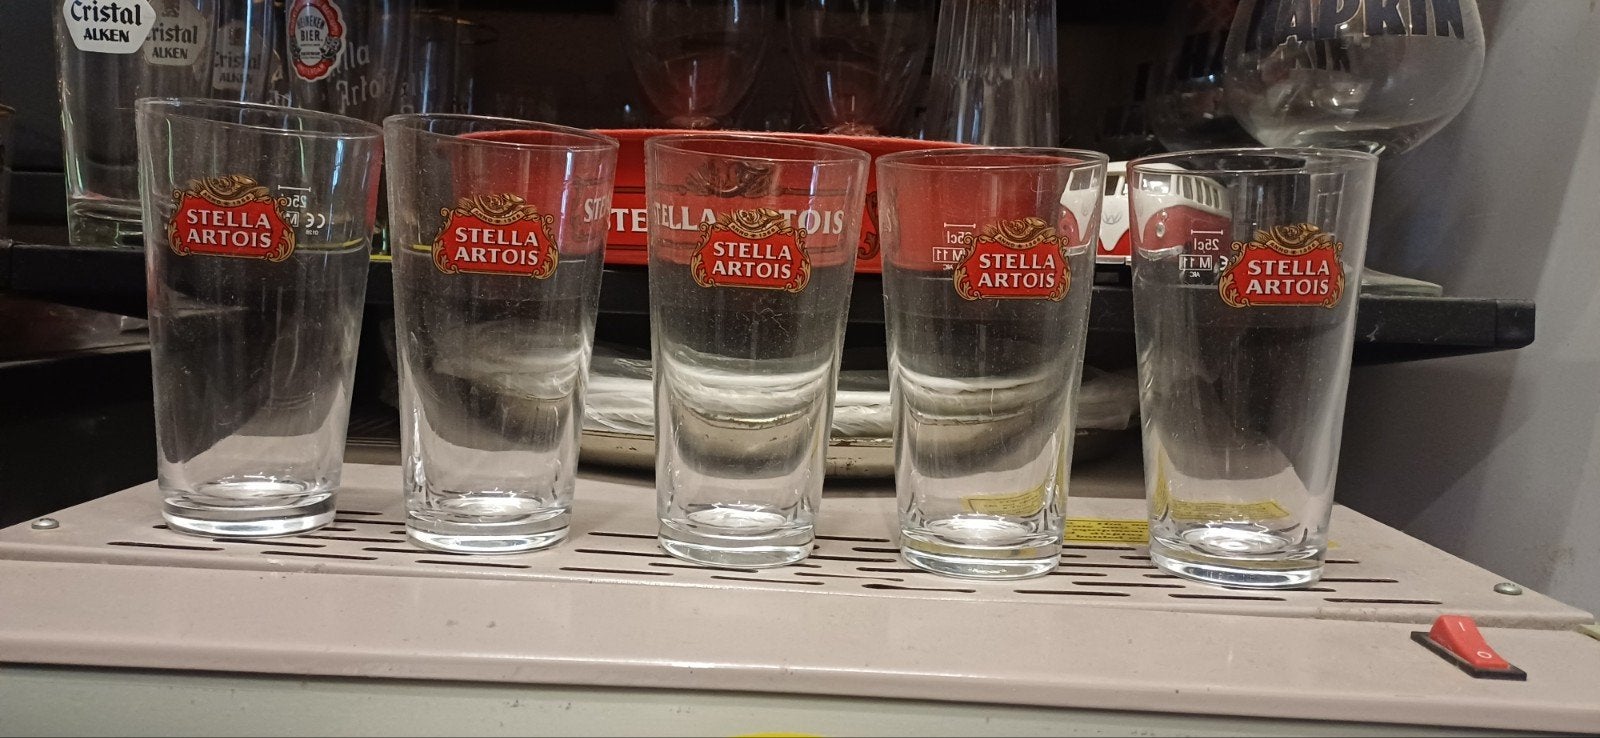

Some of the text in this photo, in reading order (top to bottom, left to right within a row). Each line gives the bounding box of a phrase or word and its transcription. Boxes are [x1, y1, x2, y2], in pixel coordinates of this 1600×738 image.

[70, 0, 142, 26] Cristal
[84, 28, 130, 42] ALKEN
[147, 23, 198, 44] ristal
[152, 47, 188, 59] ALKEN
[186, 209, 271, 229] STELLA
[778, 209, 845, 235] TOIS
[186, 229, 272, 248] ARTOIS
[455, 227, 539, 247] STELLA
[454, 246, 539, 266] ARTOIS
[713, 241, 792, 261] STELLA
[712, 260, 791, 280] ARTOIS
[978, 253, 1056, 270] STELLA
[1247, 259, 1330, 277] STELLA
[977, 272, 1056, 288] ARTOIS
[1245, 279, 1330, 296] ARTOIS
